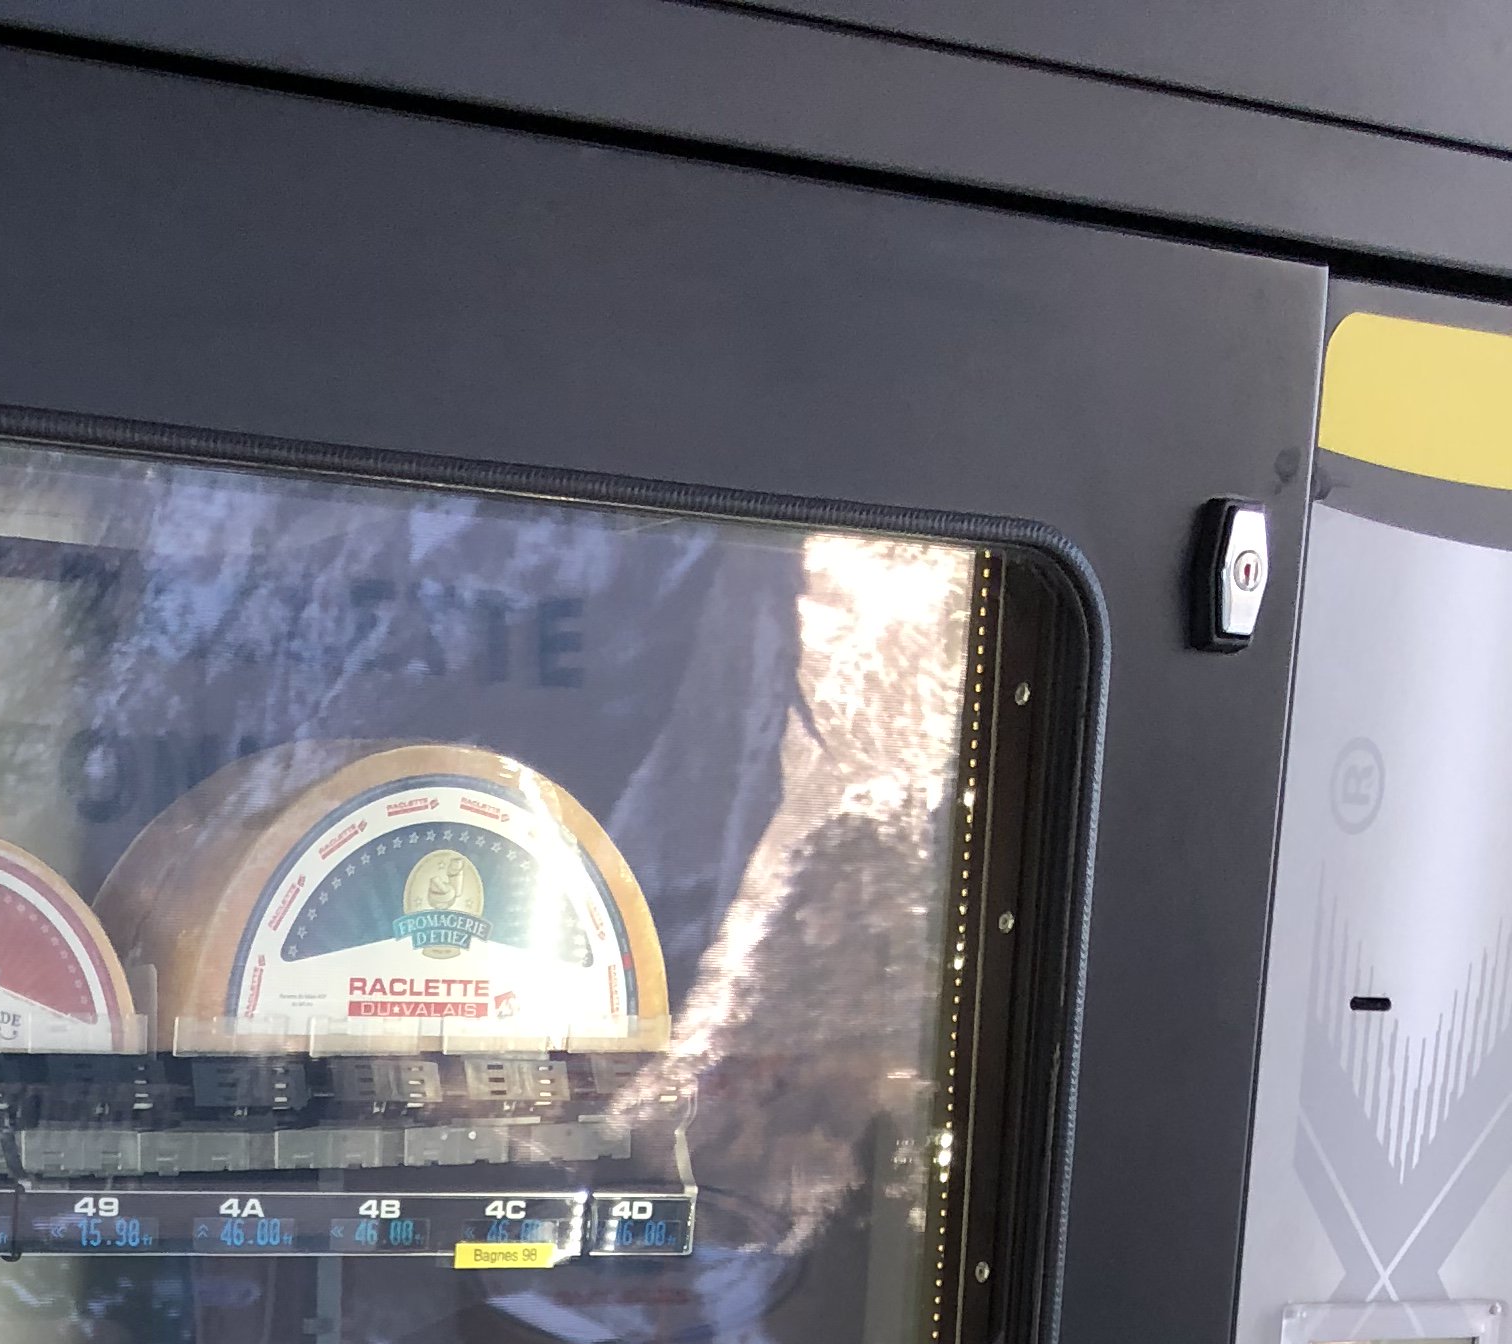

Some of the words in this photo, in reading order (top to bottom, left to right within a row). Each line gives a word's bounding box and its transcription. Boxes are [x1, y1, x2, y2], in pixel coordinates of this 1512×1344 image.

[398, 912, 488, 939] FROMAGERIE
[348, 977, 490, 998] RACLETTE
[360, 1002, 394, 1017] DU
[400, 1001, 478, 1017] VALAIS
[74, 1197, 121, 1218] 49
[218, 1198, 265, 1219] 4A
[358, 1199, 400, 1219] 4B
[484, 1200, 527, 1220] 4C
[612, 1200, 654, 1220] 4D
[78, 1216, 141, 1248] 15.90
[219, 1219, 283, 1247] 46.00
[472, 1248, 519, 1266] Bagnes
[521, 1247, 538, 1263] 98
